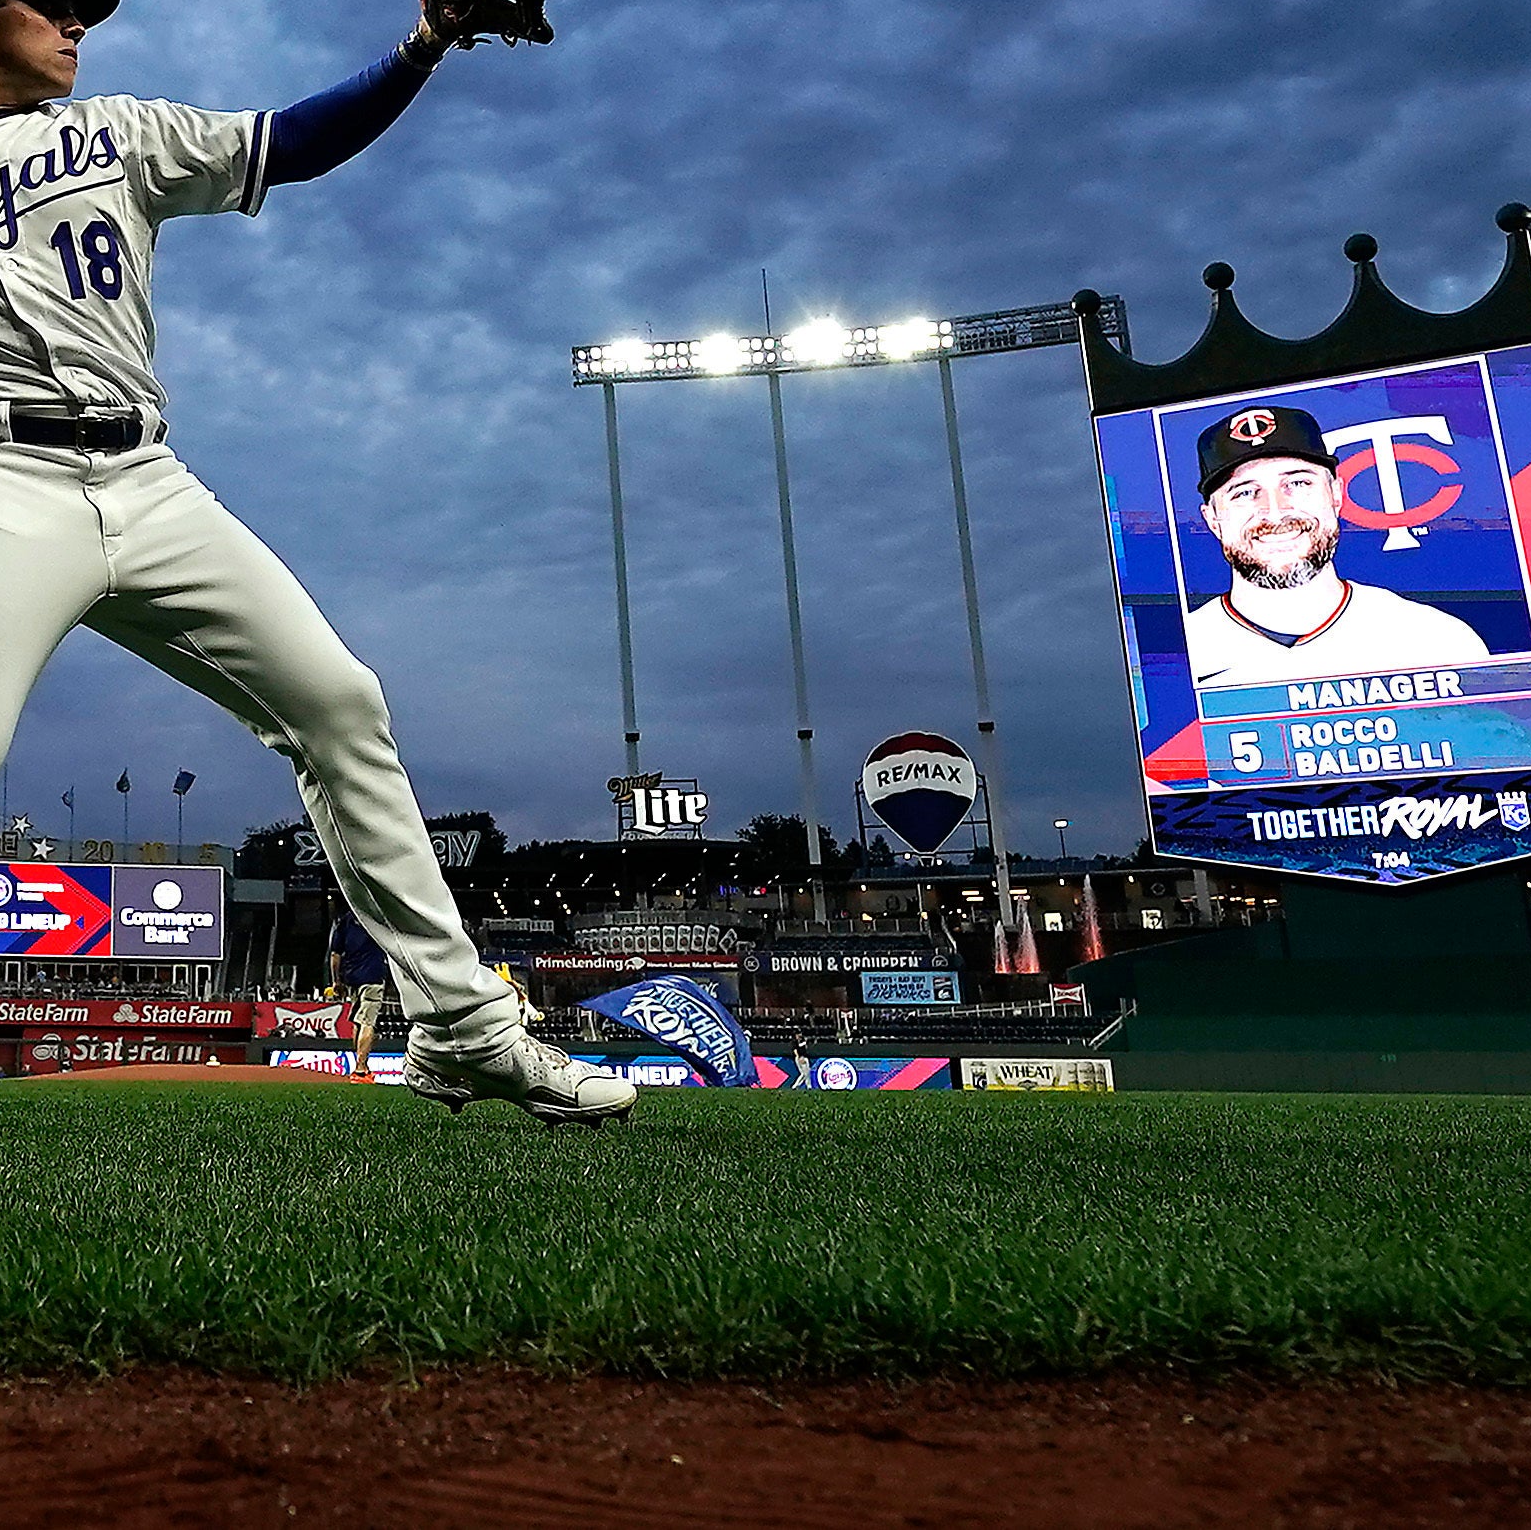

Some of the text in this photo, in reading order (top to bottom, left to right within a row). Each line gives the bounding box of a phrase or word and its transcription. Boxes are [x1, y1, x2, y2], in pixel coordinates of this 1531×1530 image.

[50, 220, 123, 300] 18
[1287, 671, 1463, 710] MANAGER
[1290, 717, 1397, 749] ROCCO
[1229, 731, 1263, 773] 5
[1294, 741, 1454, 777] BALDELLI
[876, 762, 962, 788] RE/MAX
[631, 788, 708, 836] Lite
[1246, 793, 1498, 841] TOGETHER ROYAL
[81, 839, 114, 862] 20
[1371, 852, 1411, 869] 7:04
[10, 911, 72, 931] LINEUP
[120, 907, 214, 928] Commerce
[143, 926, 191, 944] Bank
[535, 956, 624, 971] PrimeLending
[771, 956, 823, 972] BROWN
[827, 956, 839, 971] &
[140, 1004, 232, 1025] StateFarm
[620, 1065, 689, 1086] LINEUP
[999, 1064, 1054, 1080] WHEAT
